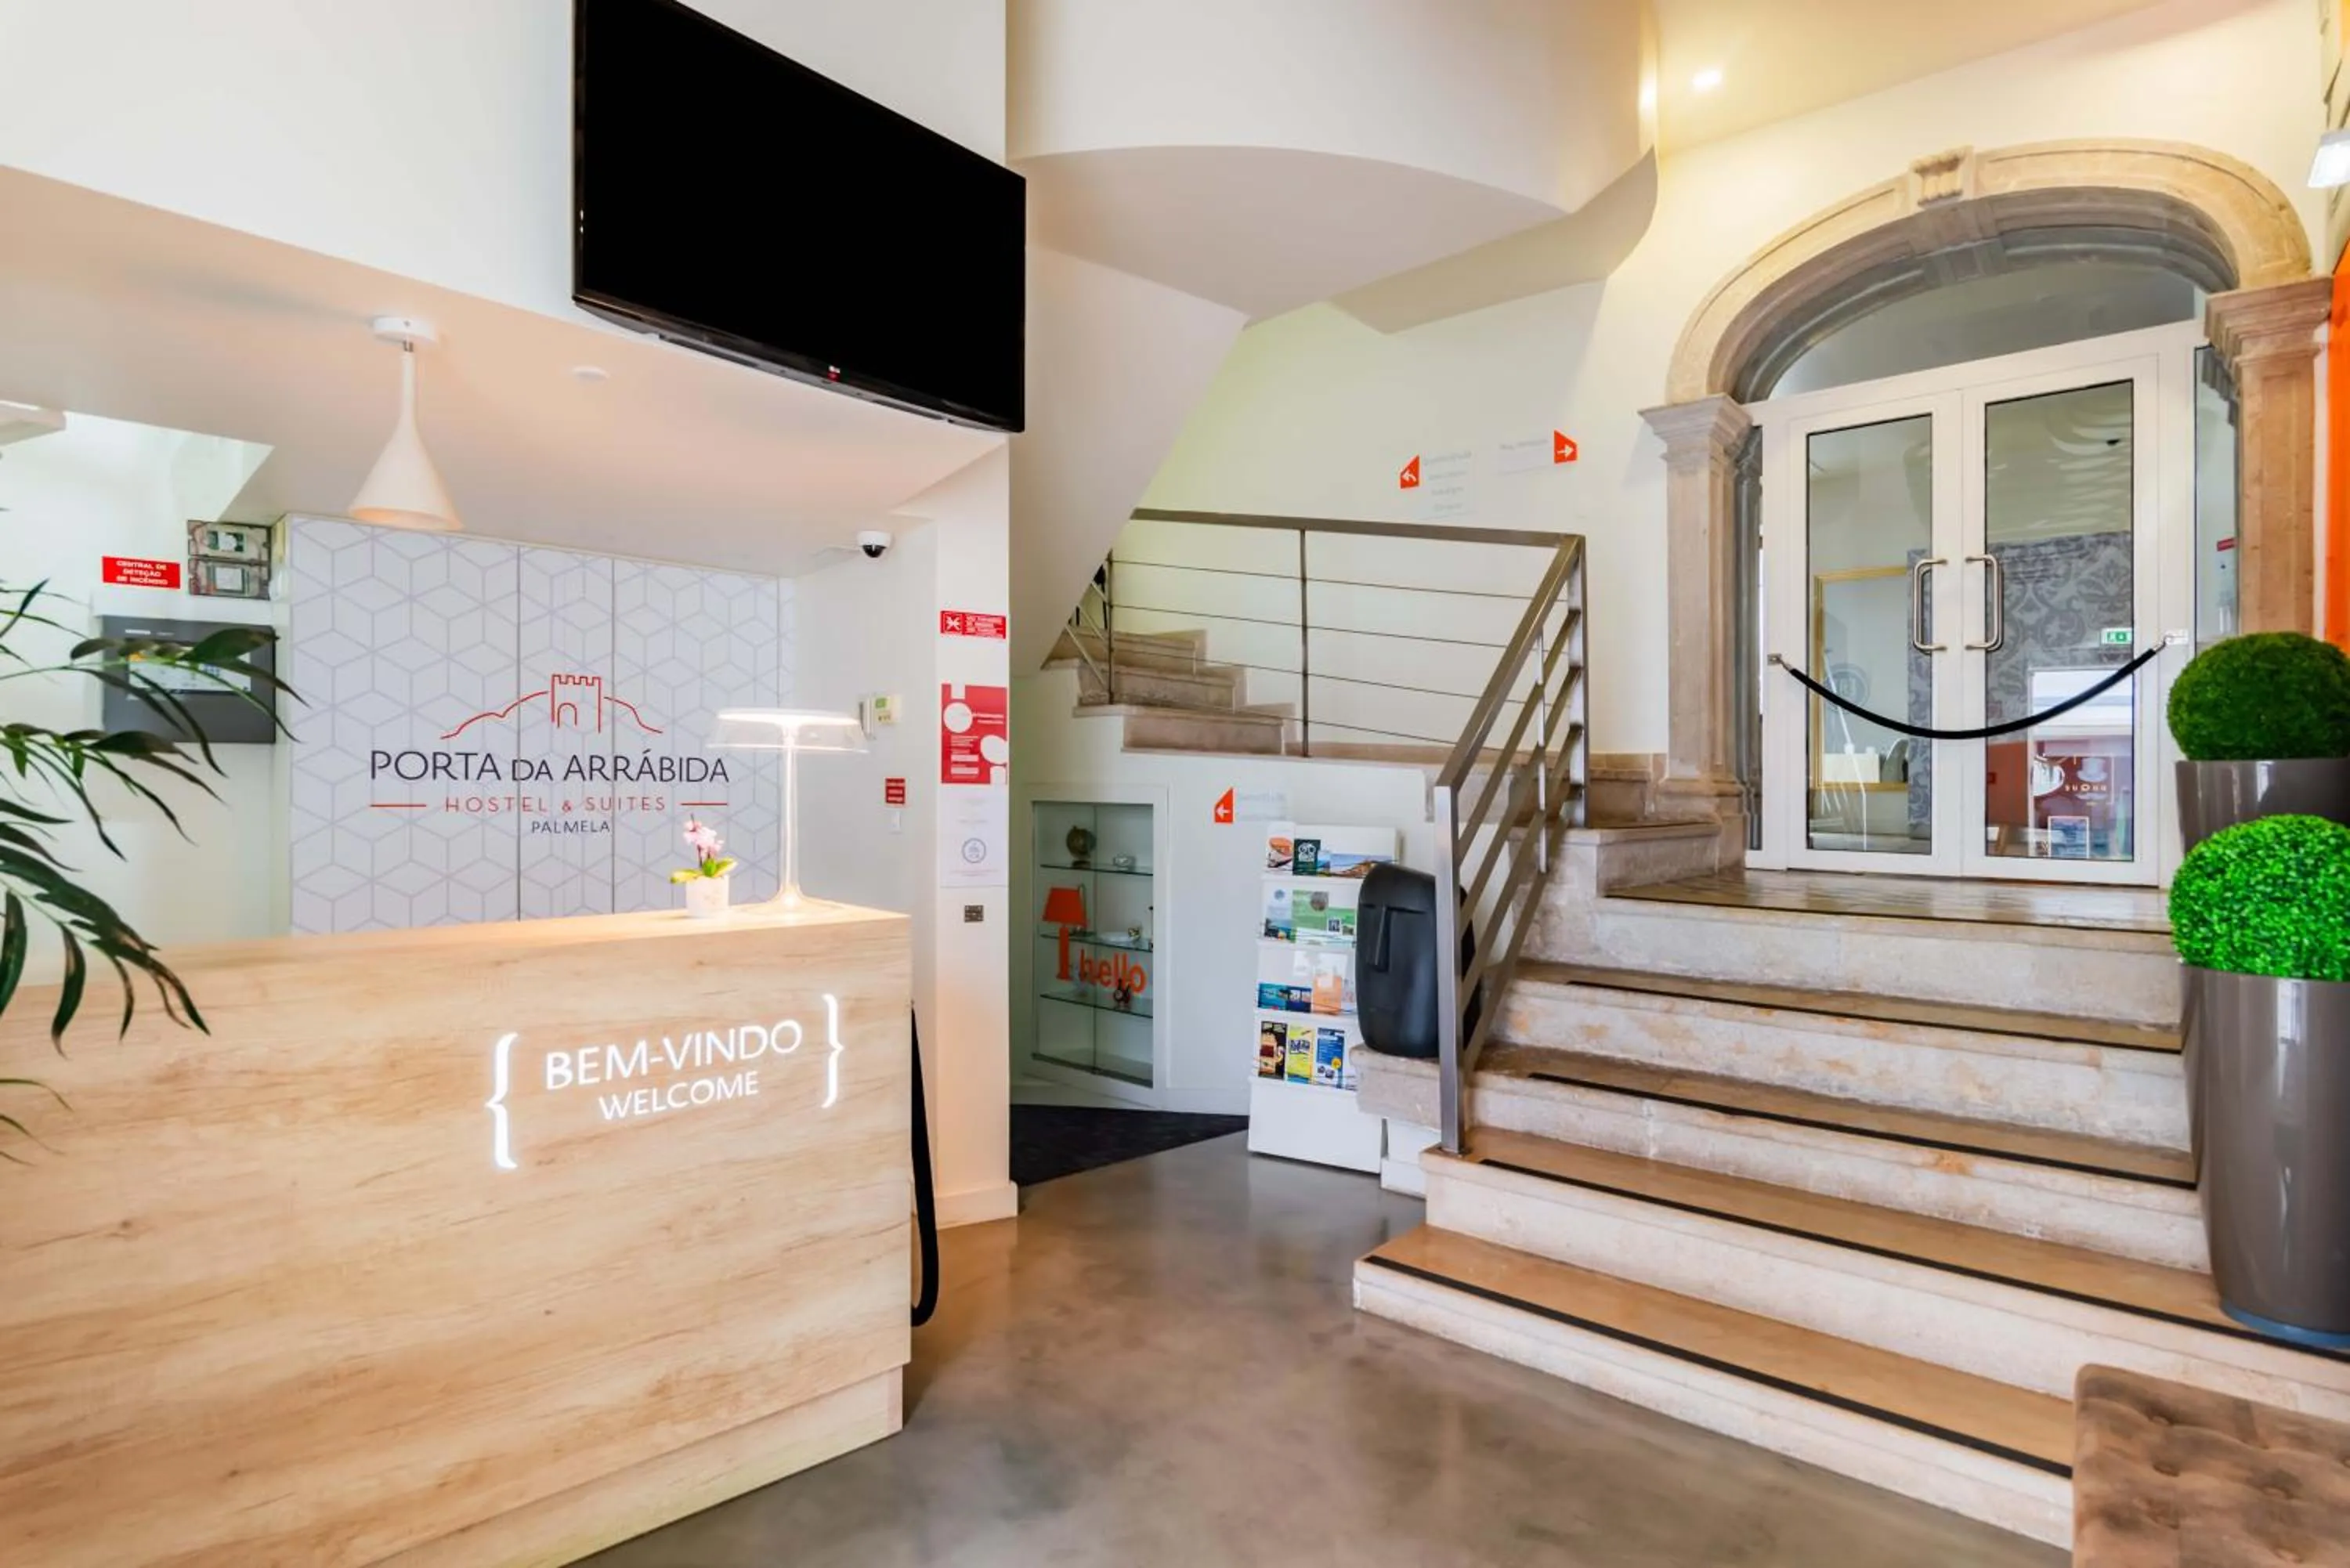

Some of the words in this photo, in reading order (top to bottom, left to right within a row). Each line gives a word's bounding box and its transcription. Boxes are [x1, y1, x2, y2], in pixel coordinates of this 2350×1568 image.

[371, 750, 502, 781] PORTA
[511, 759, 555, 781] DA
[562, 749, 729, 782] ARRÁBIDA
[446, 797, 547, 812] HOSTEL
[562, 799, 572, 811] &
[584, 797, 666, 811] SUITES
[532, 820, 611, 833] PALMELA
[1079, 948, 1146, 994] hello
[546, 1020, 803, 1090] BEM-VINDO
[598, 1071, 760, 1120] WELCOME
